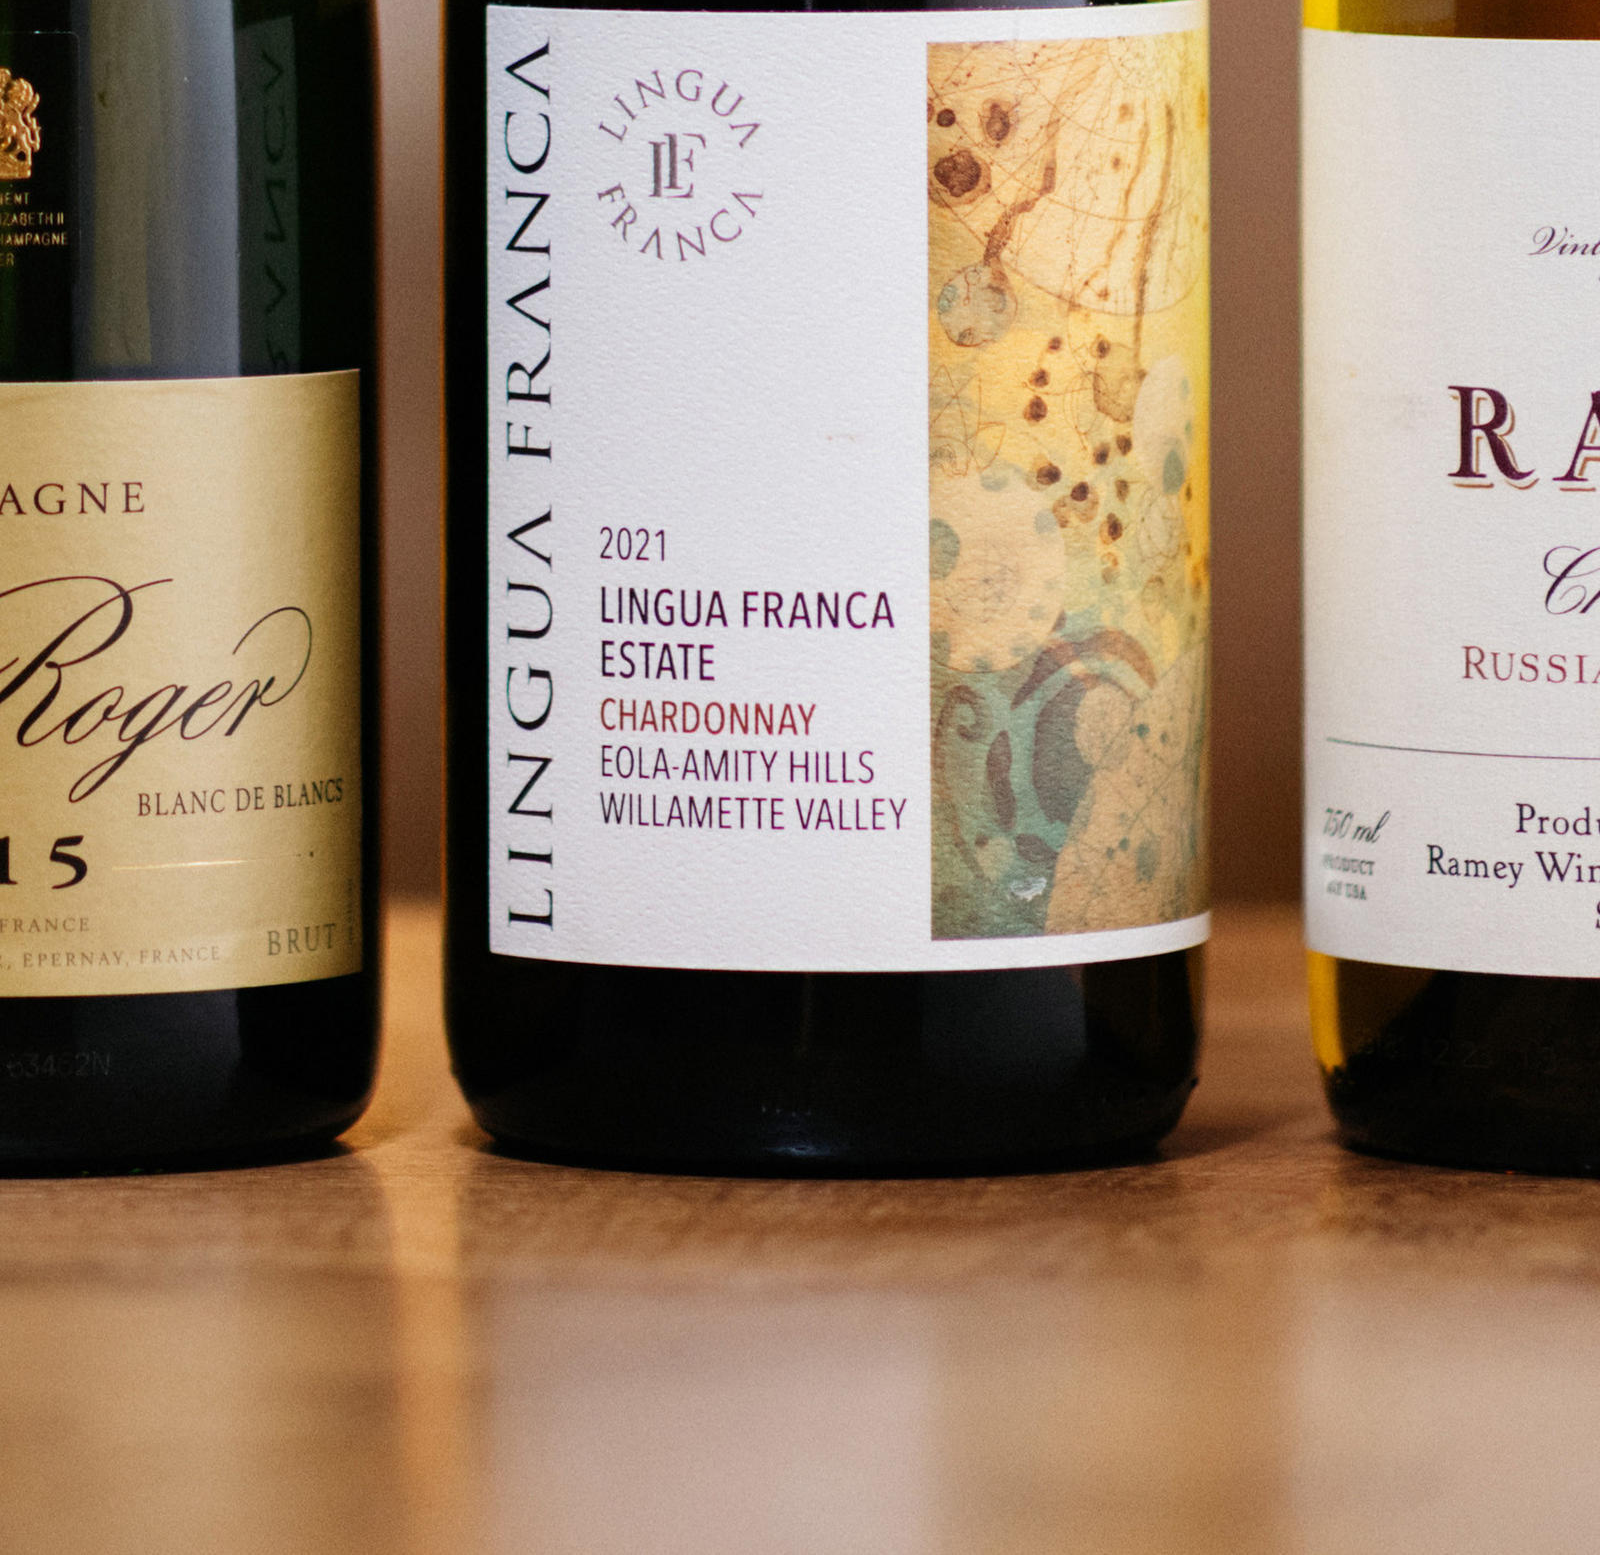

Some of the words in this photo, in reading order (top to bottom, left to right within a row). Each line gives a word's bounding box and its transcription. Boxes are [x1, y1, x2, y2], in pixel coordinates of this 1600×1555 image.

[599, 67, 762, 148] LINGUA
[597, 182, 763, 263] FRANCA
[504, 38, 553, 463] FRANCA
[599, 526, 667, 562] 2021
[599, 585, 728, 629] LINGUA
[742, 590, 895, 630] FRANCA
[600, 639, 716, 682] ESTATE
[505, 504, 555, 932] LINGUA
[599, 697, 817, 737] CHARDONNAY
[599, 745, 777, 784] EOLA-AMITY
[788, 749, 875, 785] HILLS
[138, 786, 226, 818] BLANC
[236, 783, 267, 812] DE
[273, 777, 345, 810] BLANCS
[599, 791, 785, 831] WILLAMETTE
[795, 797, 908, 832] VALLEY
[1323, 807, 1354, 839] 750
[1352, 810, 1392, 844] ml
[1426, 844, 1525, 889] Ramey
[0, 916, 90, 933] FRANCE
[266, 922, 338, 958] BRUT
[139, 945, 221, 966] FRANCE
